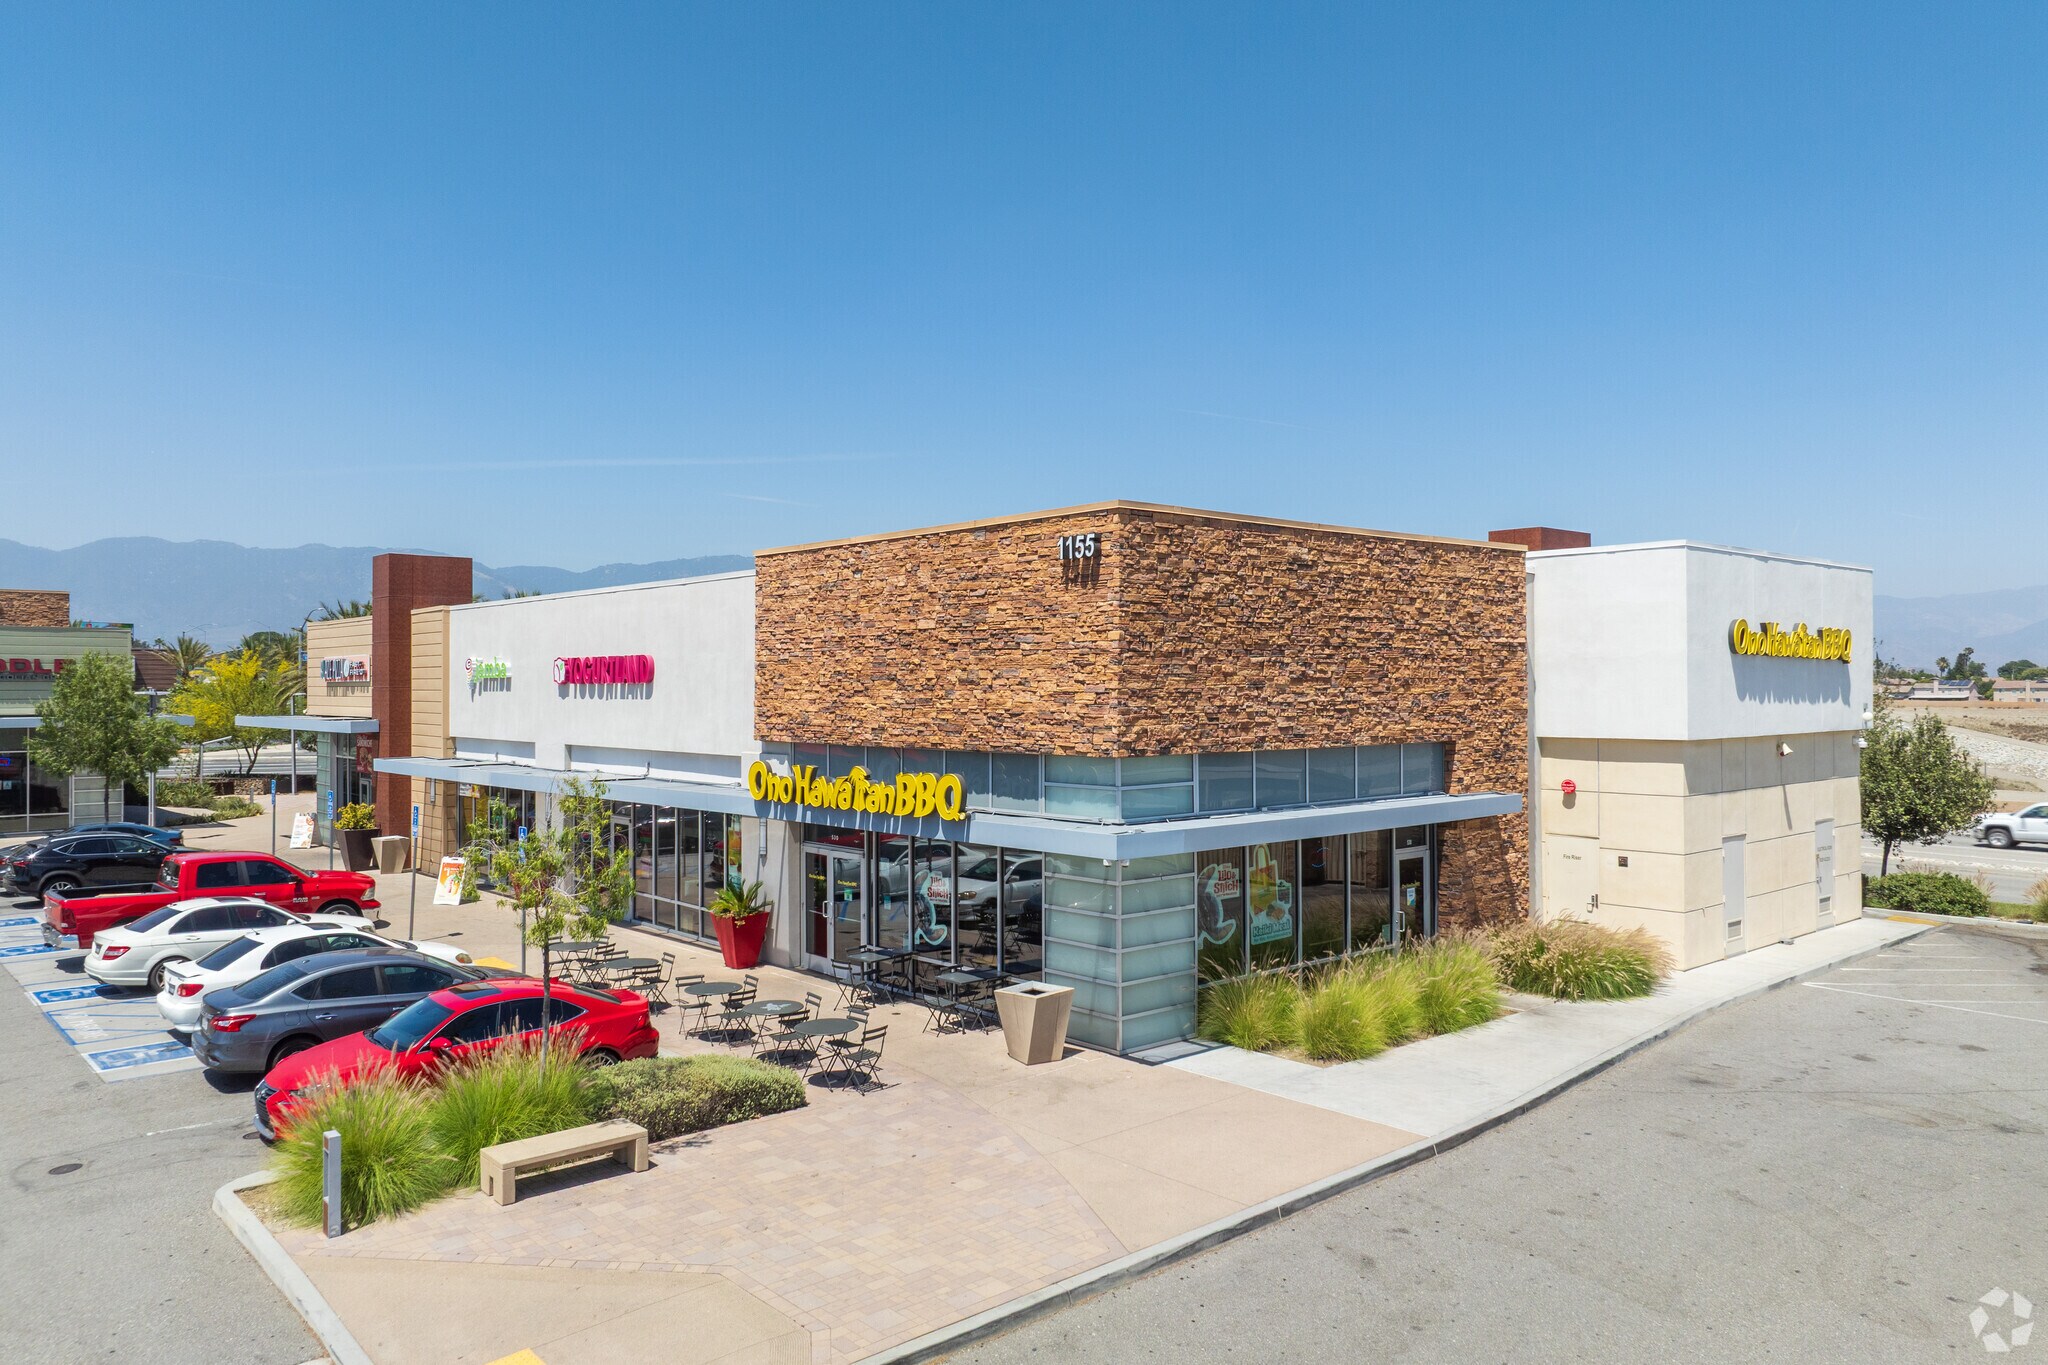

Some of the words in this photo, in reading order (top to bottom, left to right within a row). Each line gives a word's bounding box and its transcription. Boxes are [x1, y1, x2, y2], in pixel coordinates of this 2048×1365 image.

[1057, 533, 1096, 560] 1155
[1730, 618, 1767, 656] Ono
[1820, 626, 1852, 664] BBQ
[474, 656, 507, 683] jamba
[567, 655, 654, 684] YOGURTLAND
[748, 760, 796, 804] Ono
[894, 772, 966, 822] BBQ
